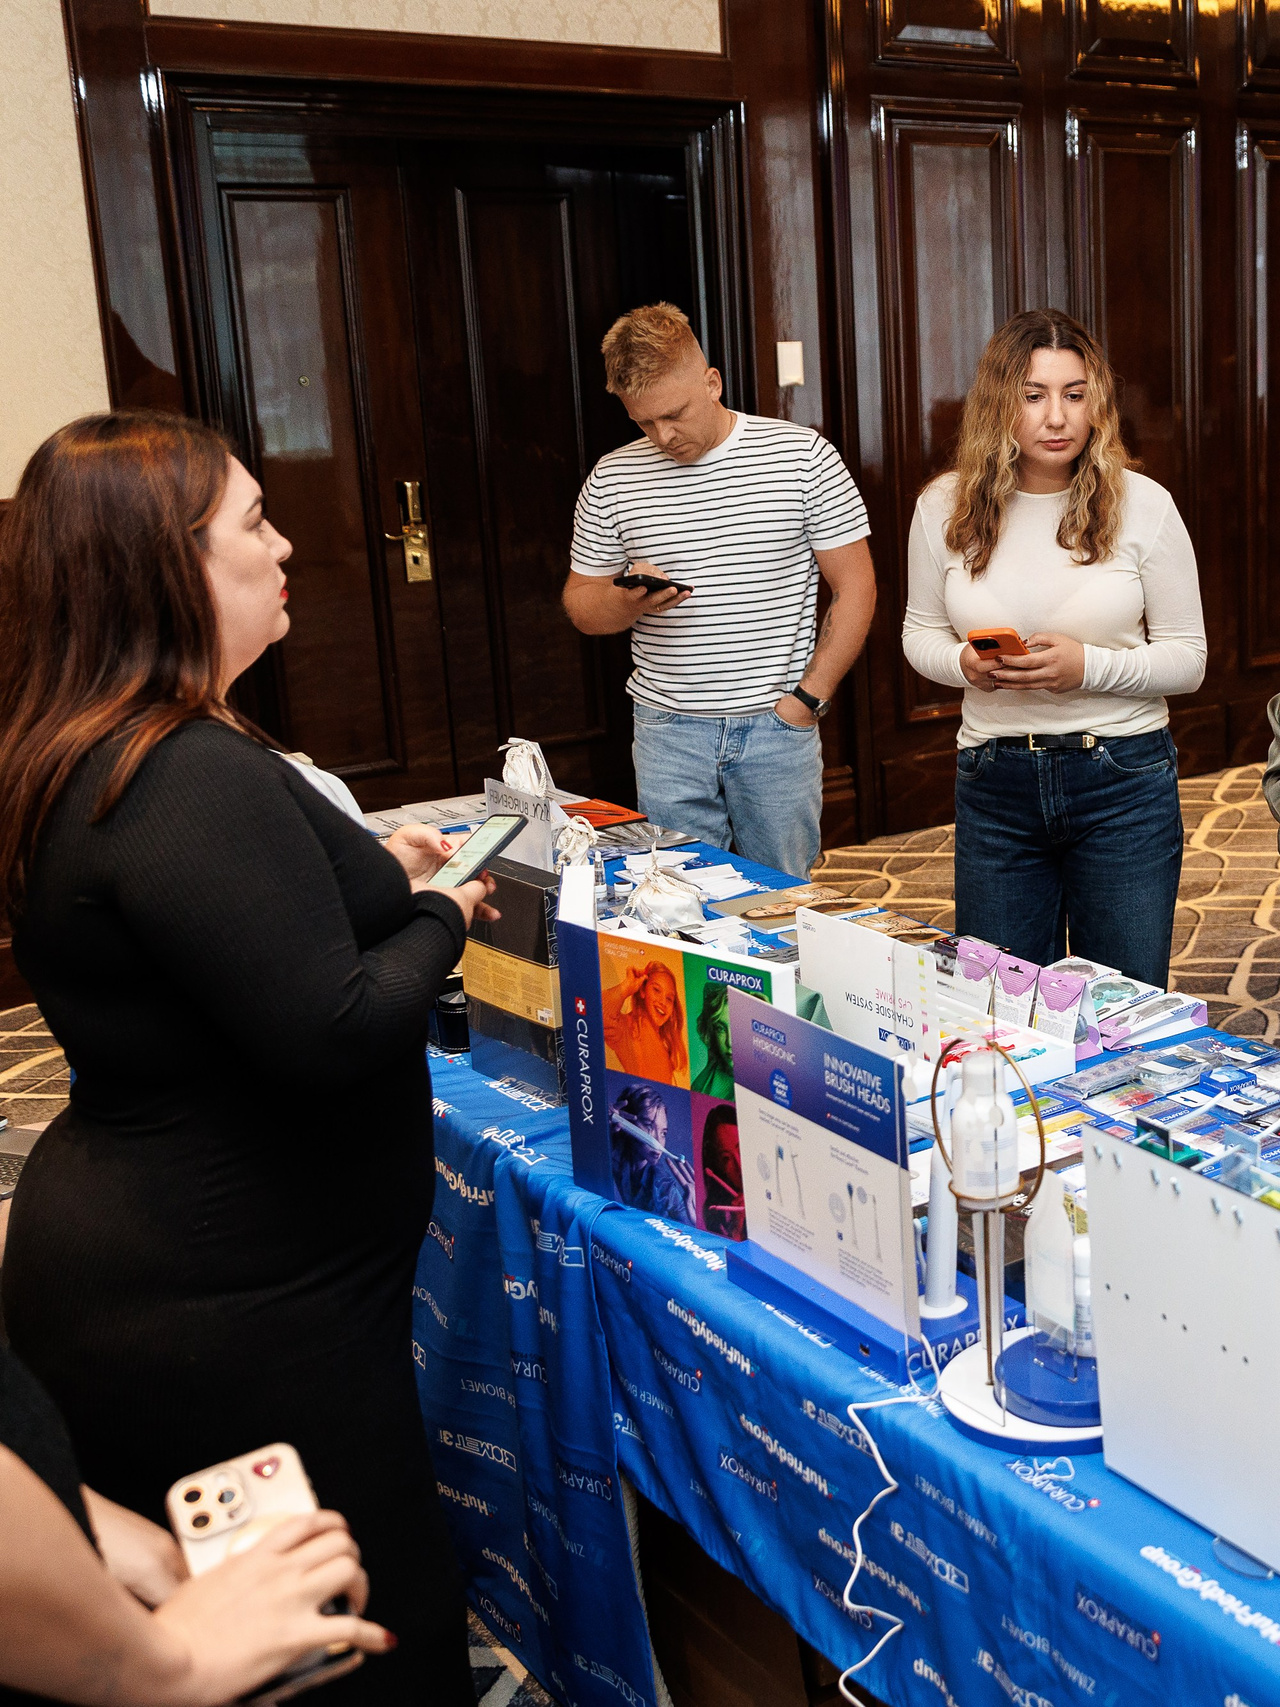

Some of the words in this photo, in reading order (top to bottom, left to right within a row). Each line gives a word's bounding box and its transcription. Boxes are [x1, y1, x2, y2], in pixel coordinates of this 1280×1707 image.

[708, 968, 762, 991] CURAPROX
[845, 992, 873, 1011] SYSTEM
[752, 1036, 796, 1065] HYDROSONIC
[753, 1020, 785, 1043] CURAPROX
[576, 1018, 594, 1124] CURAPROX
[824, 1053, 882, 1091] INNOVATIVE
[825, 1071, 855, 1097] BRUSH
[858, 1086, 891, 1113] HEADS
[645, 1217, 726, 1271] HuFriedyGroup
[667, 1298, 751, 1375] HuFriedyGroup
[460, 1378, 505, 1400] BIOMET
[455, 1434, 517, 1472] BIOMET
[739, 1413, 828, 1496] HuFriedyGroup
[719, 1452, 778, 1503] CURAPROX
[1076, 1592, 1158, 1662] CURAPROX
